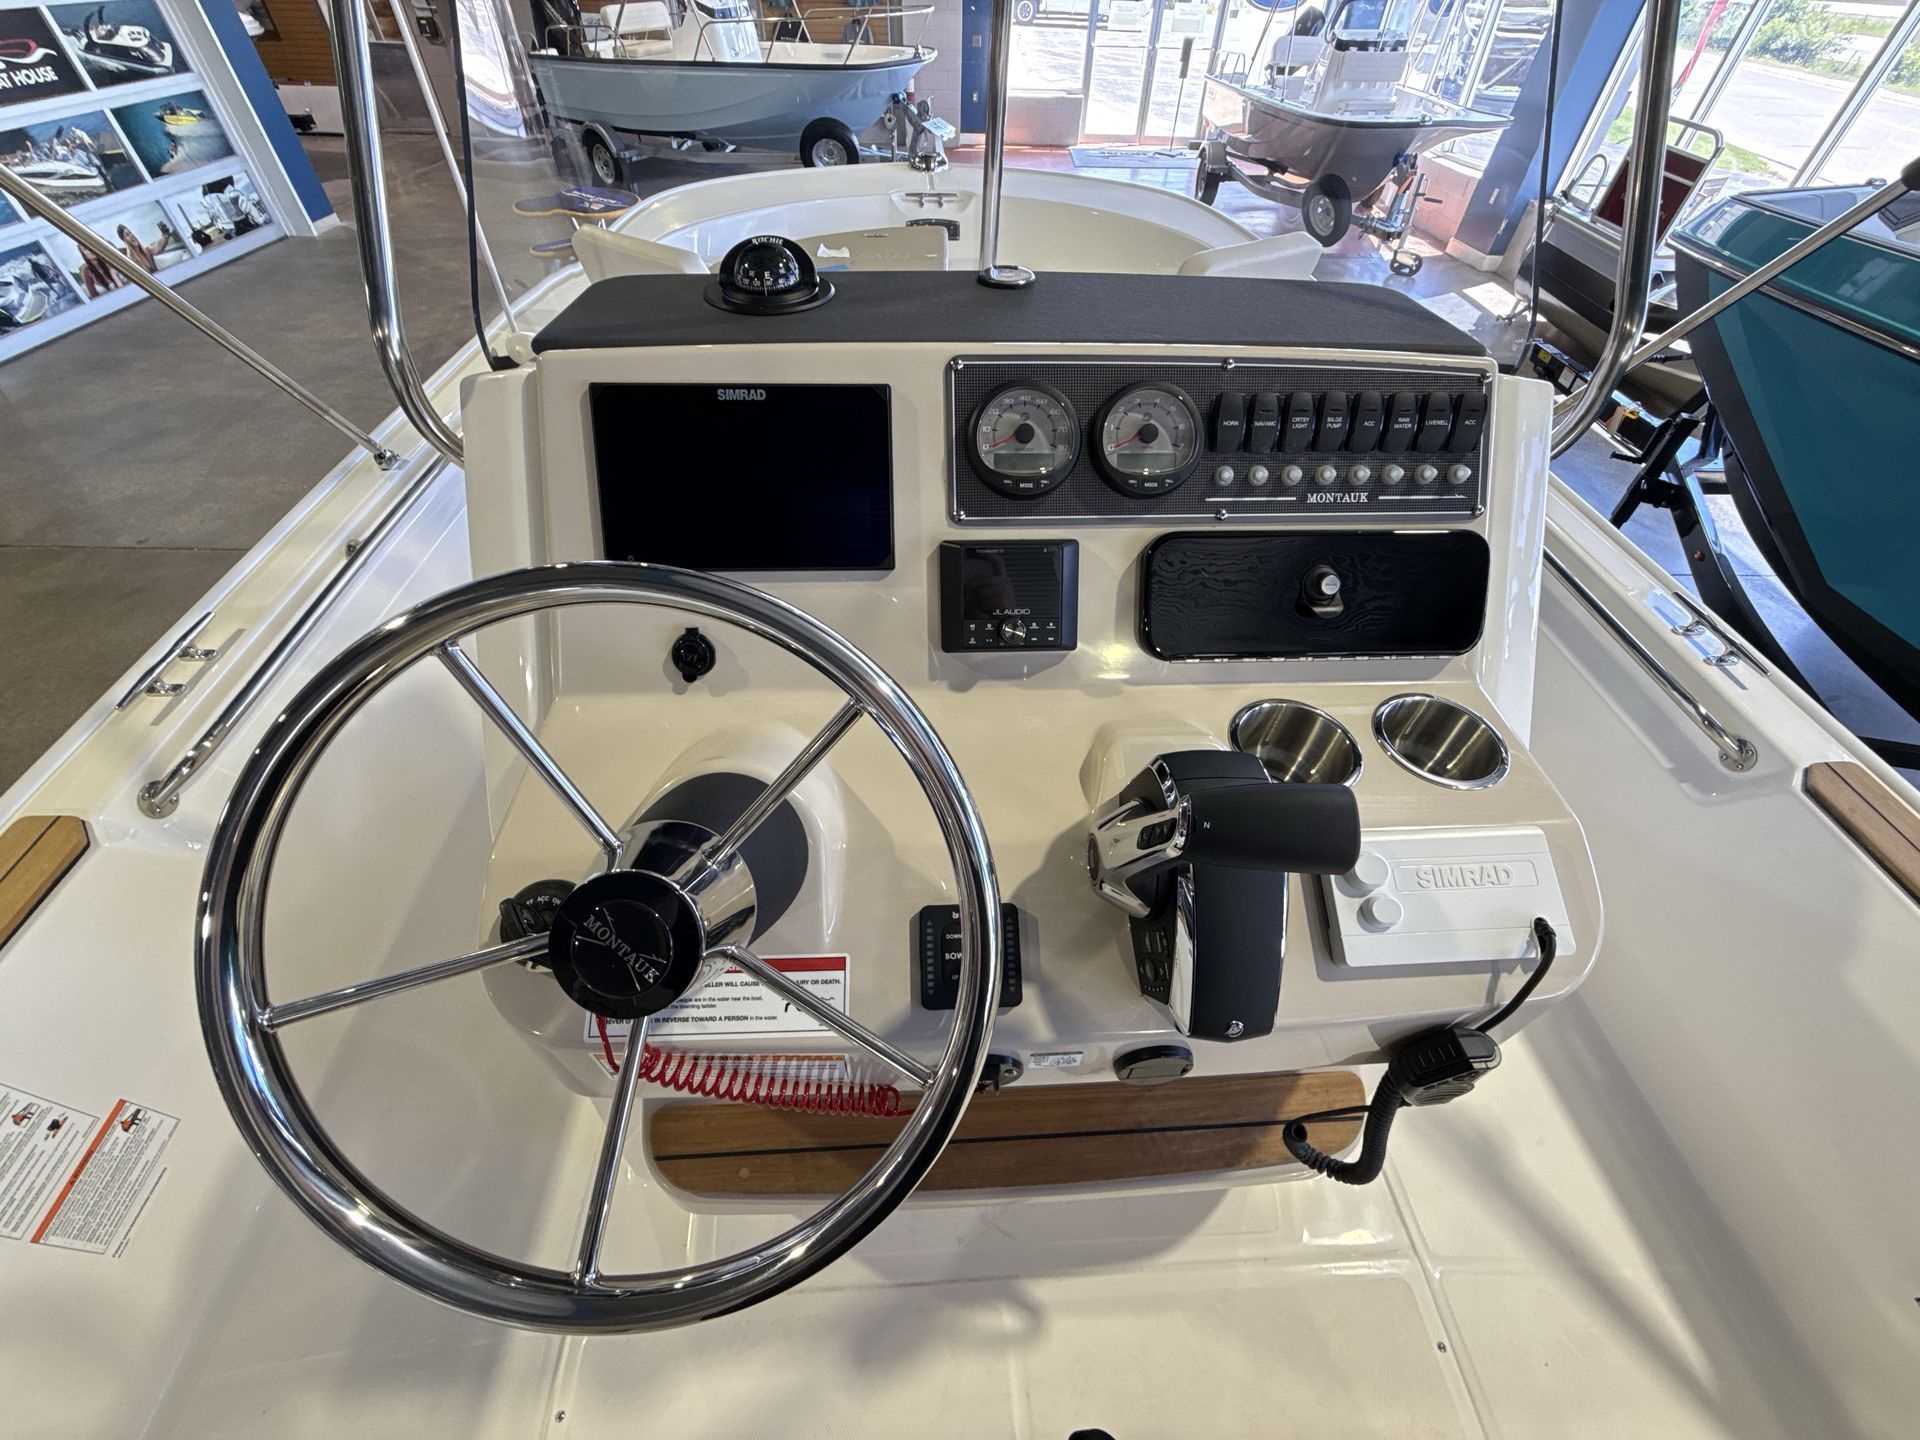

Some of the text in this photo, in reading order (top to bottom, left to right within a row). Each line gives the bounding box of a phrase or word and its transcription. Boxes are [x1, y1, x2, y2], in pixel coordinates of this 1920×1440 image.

[0, 66, 59, 89] AT HOUSE
[752, 236, 784, 245] RITCHIE
[764, 271, 770, 279] E
[717, 389, 766, 400] SIMRAD
[1306, 492, 1368, 503] MONTAUK
[1203, 821, 1211, 829] N
[1416, 864, 1515, 889] SIMRAD
[583, 914, 660, 983] MONTAUK
